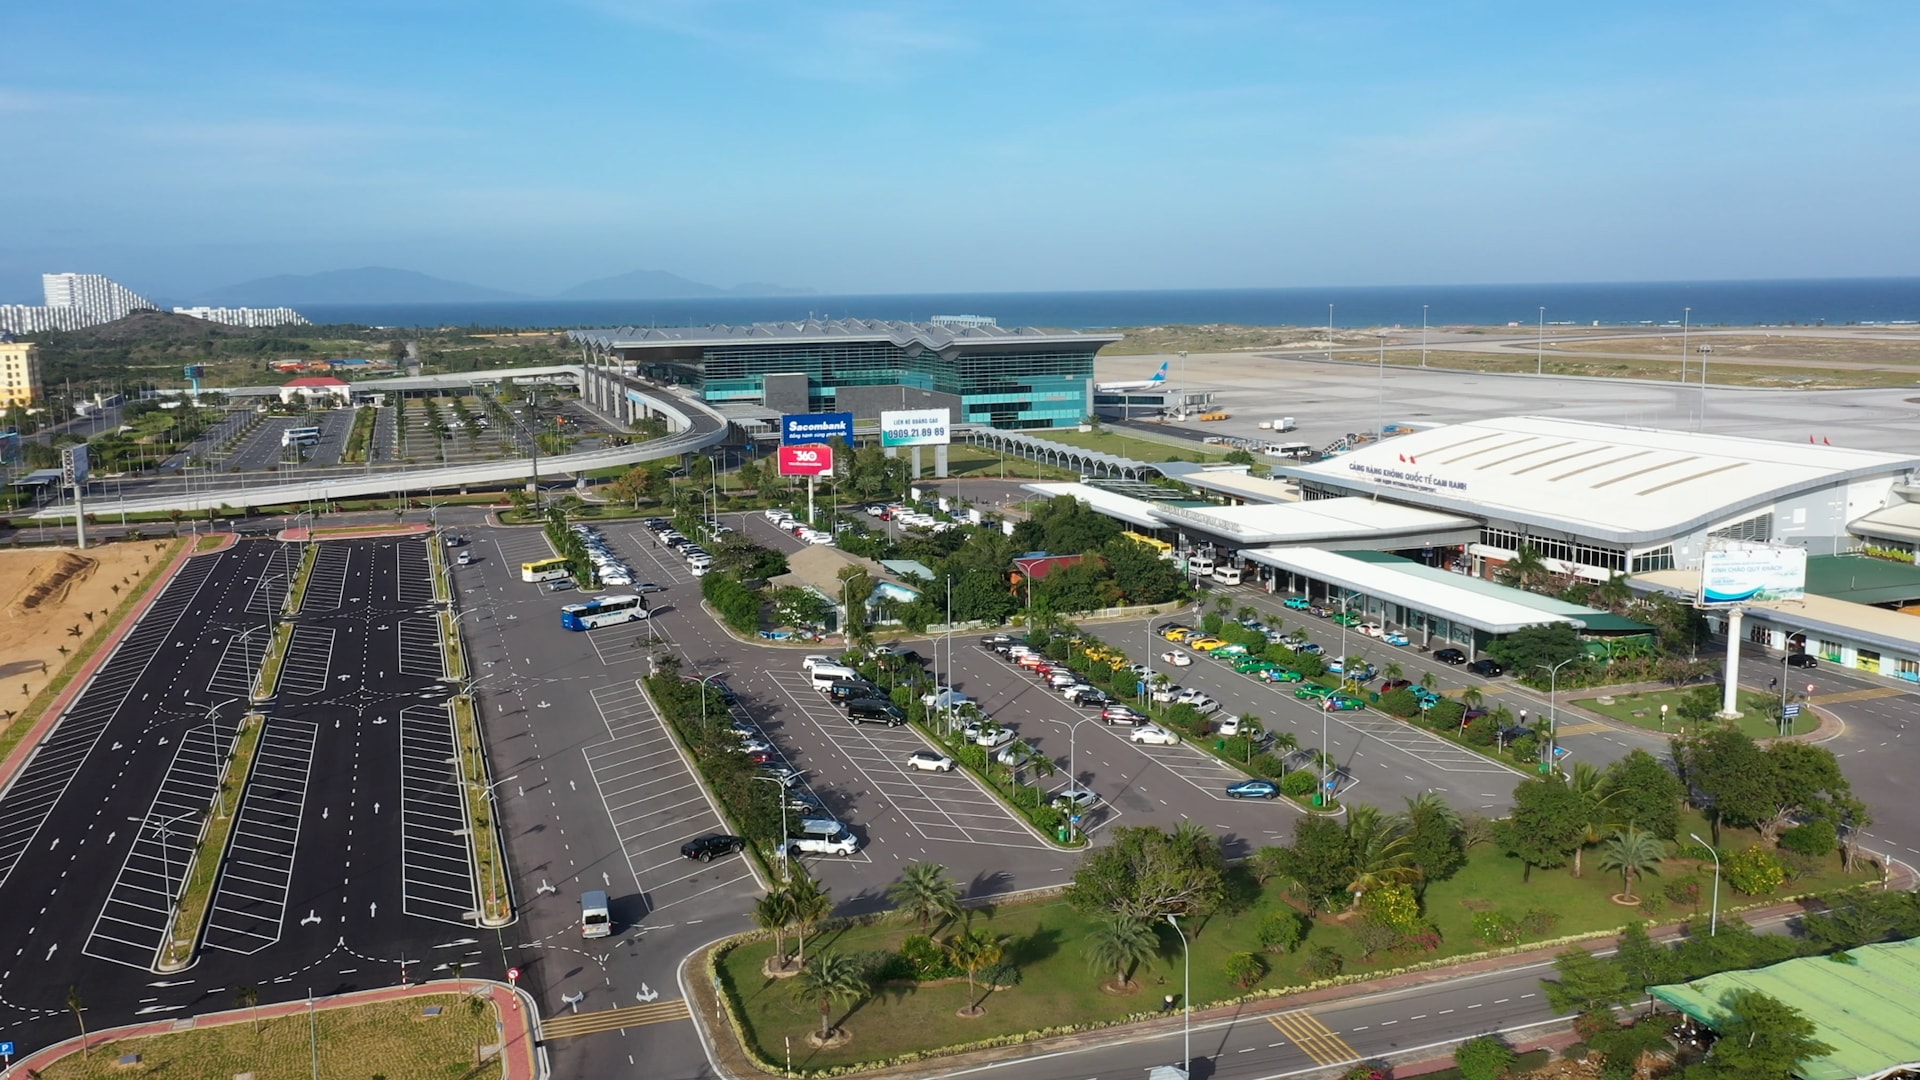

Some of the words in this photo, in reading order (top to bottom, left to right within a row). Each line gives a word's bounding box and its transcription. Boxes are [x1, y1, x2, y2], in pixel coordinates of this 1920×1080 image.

[788, 420, 847, 432] Sacombank
[888, 429, 909, 439] 0909
[911, 428, 919, 437] 21
[921, 427, 932, 437] 89
[934, 427, 945, 436] 89
[796, 450, 818, 462] 360
[1405, 470, 1423, 483] QUỐC
[1424, 474, 1433, 484] TẾ
[1433, 478, 1447, 487] CAM
[1448, 480, 1467, 491] RANH
[2, 1044, 9, 1052] P
